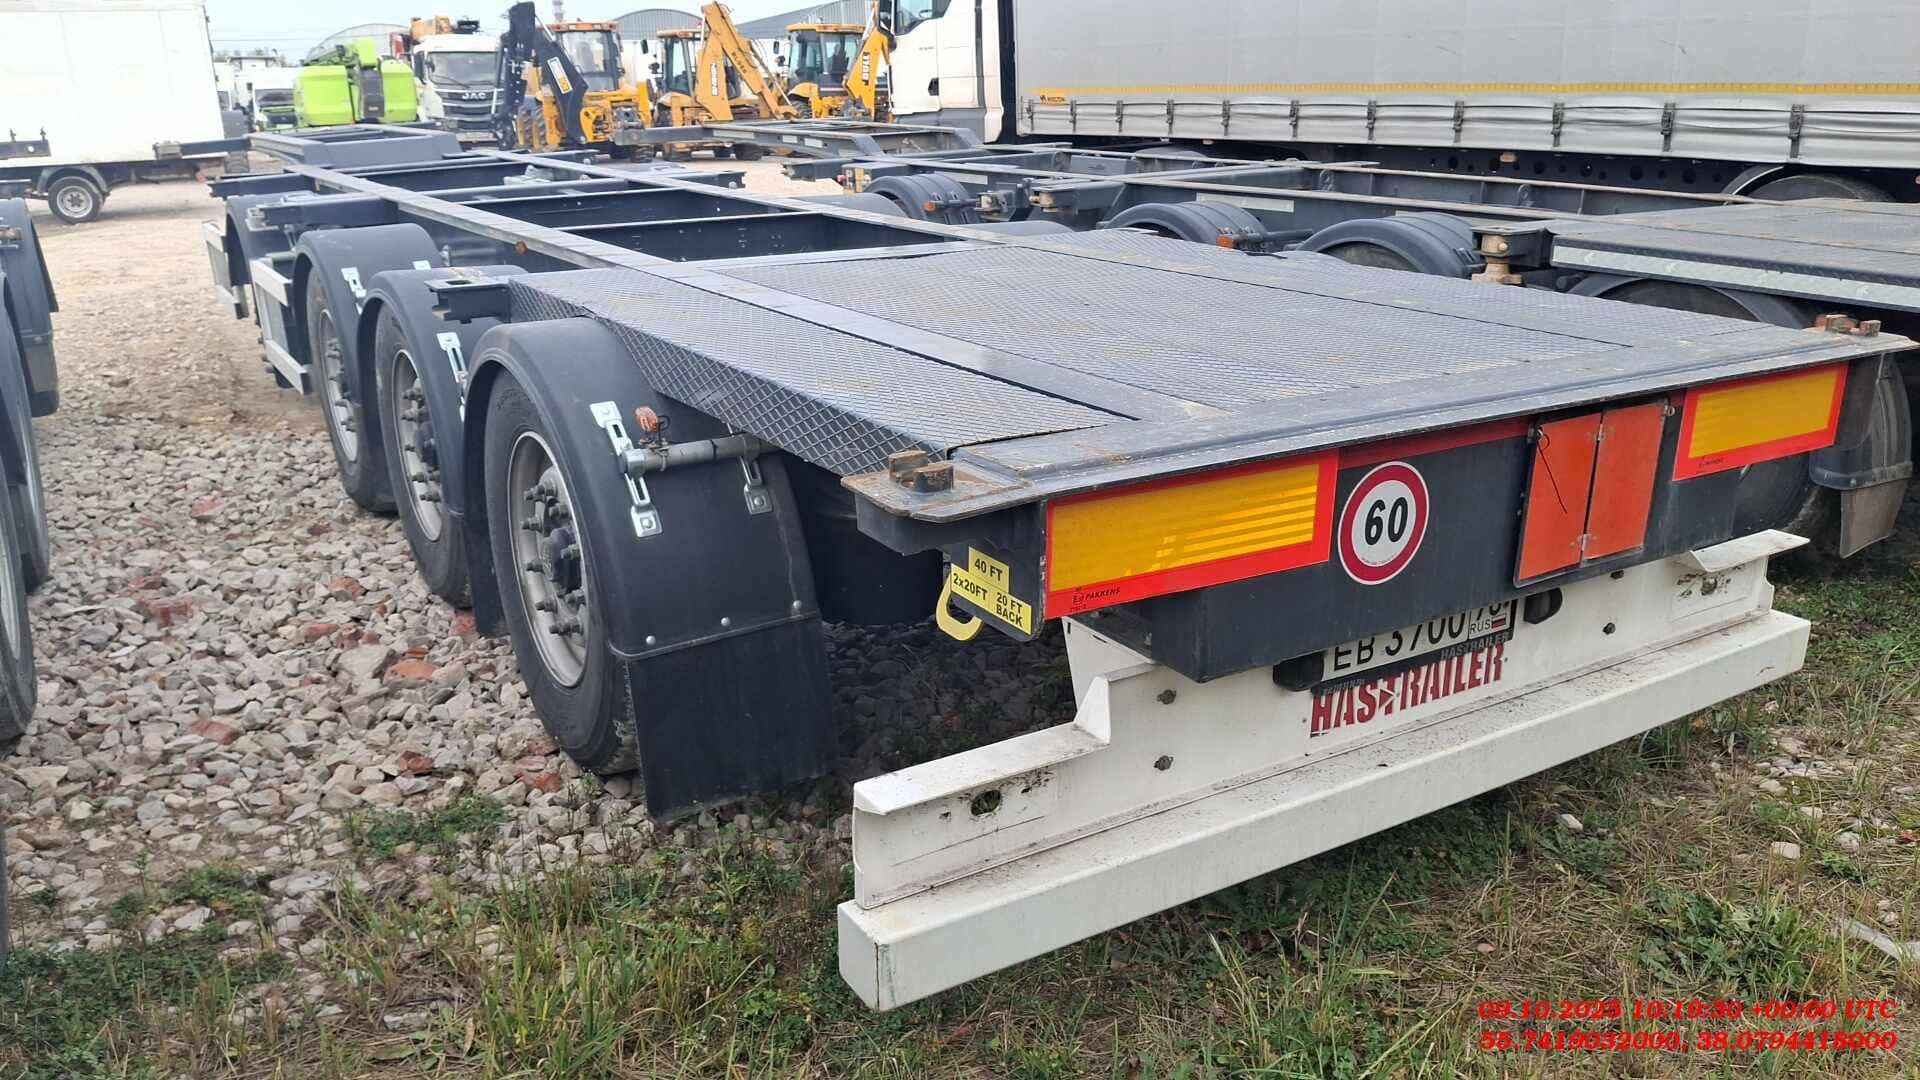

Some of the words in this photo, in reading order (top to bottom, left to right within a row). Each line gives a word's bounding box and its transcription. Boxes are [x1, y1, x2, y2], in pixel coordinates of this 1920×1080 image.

[461, 92, 487, 100] JAC
[1364, 496, 1409, 546] 60
[974, 557, 987, 574] 40
[990, 564, 1003, 582] FT
[953, 572, 988, 601] 2x20FT
[997, 591, 1008, 606] 20
[1010, 598, 1023, 614] FT
[996, 604, 1024, 628] BACK
[1470, 618, 1490, 633] RUS
[1310, 642, 1505, 733] HASTRAILER
